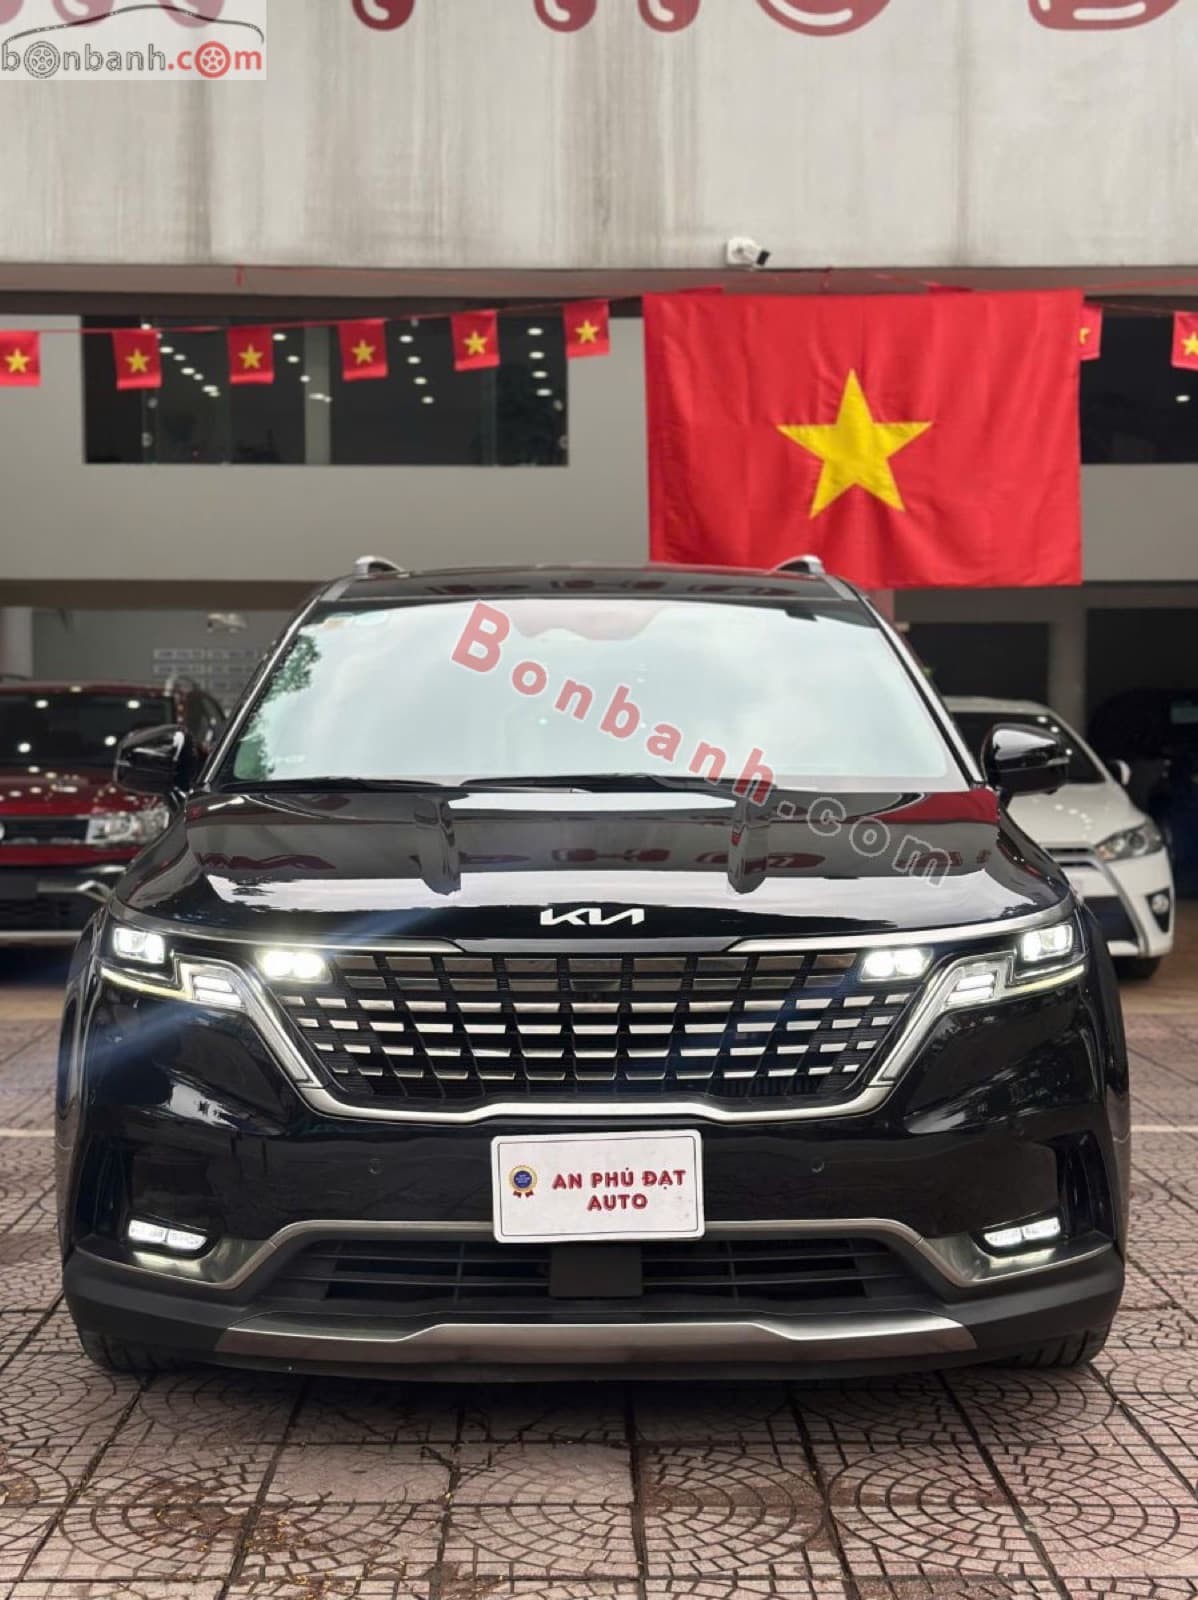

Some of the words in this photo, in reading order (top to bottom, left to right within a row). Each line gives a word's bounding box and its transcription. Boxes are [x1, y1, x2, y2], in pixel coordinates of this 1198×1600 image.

[552, 1173, 583, 1190] AN
[641, 1169, 686, 1190] ĐẠT
[587, 1193, 648, 1212] AUTO
